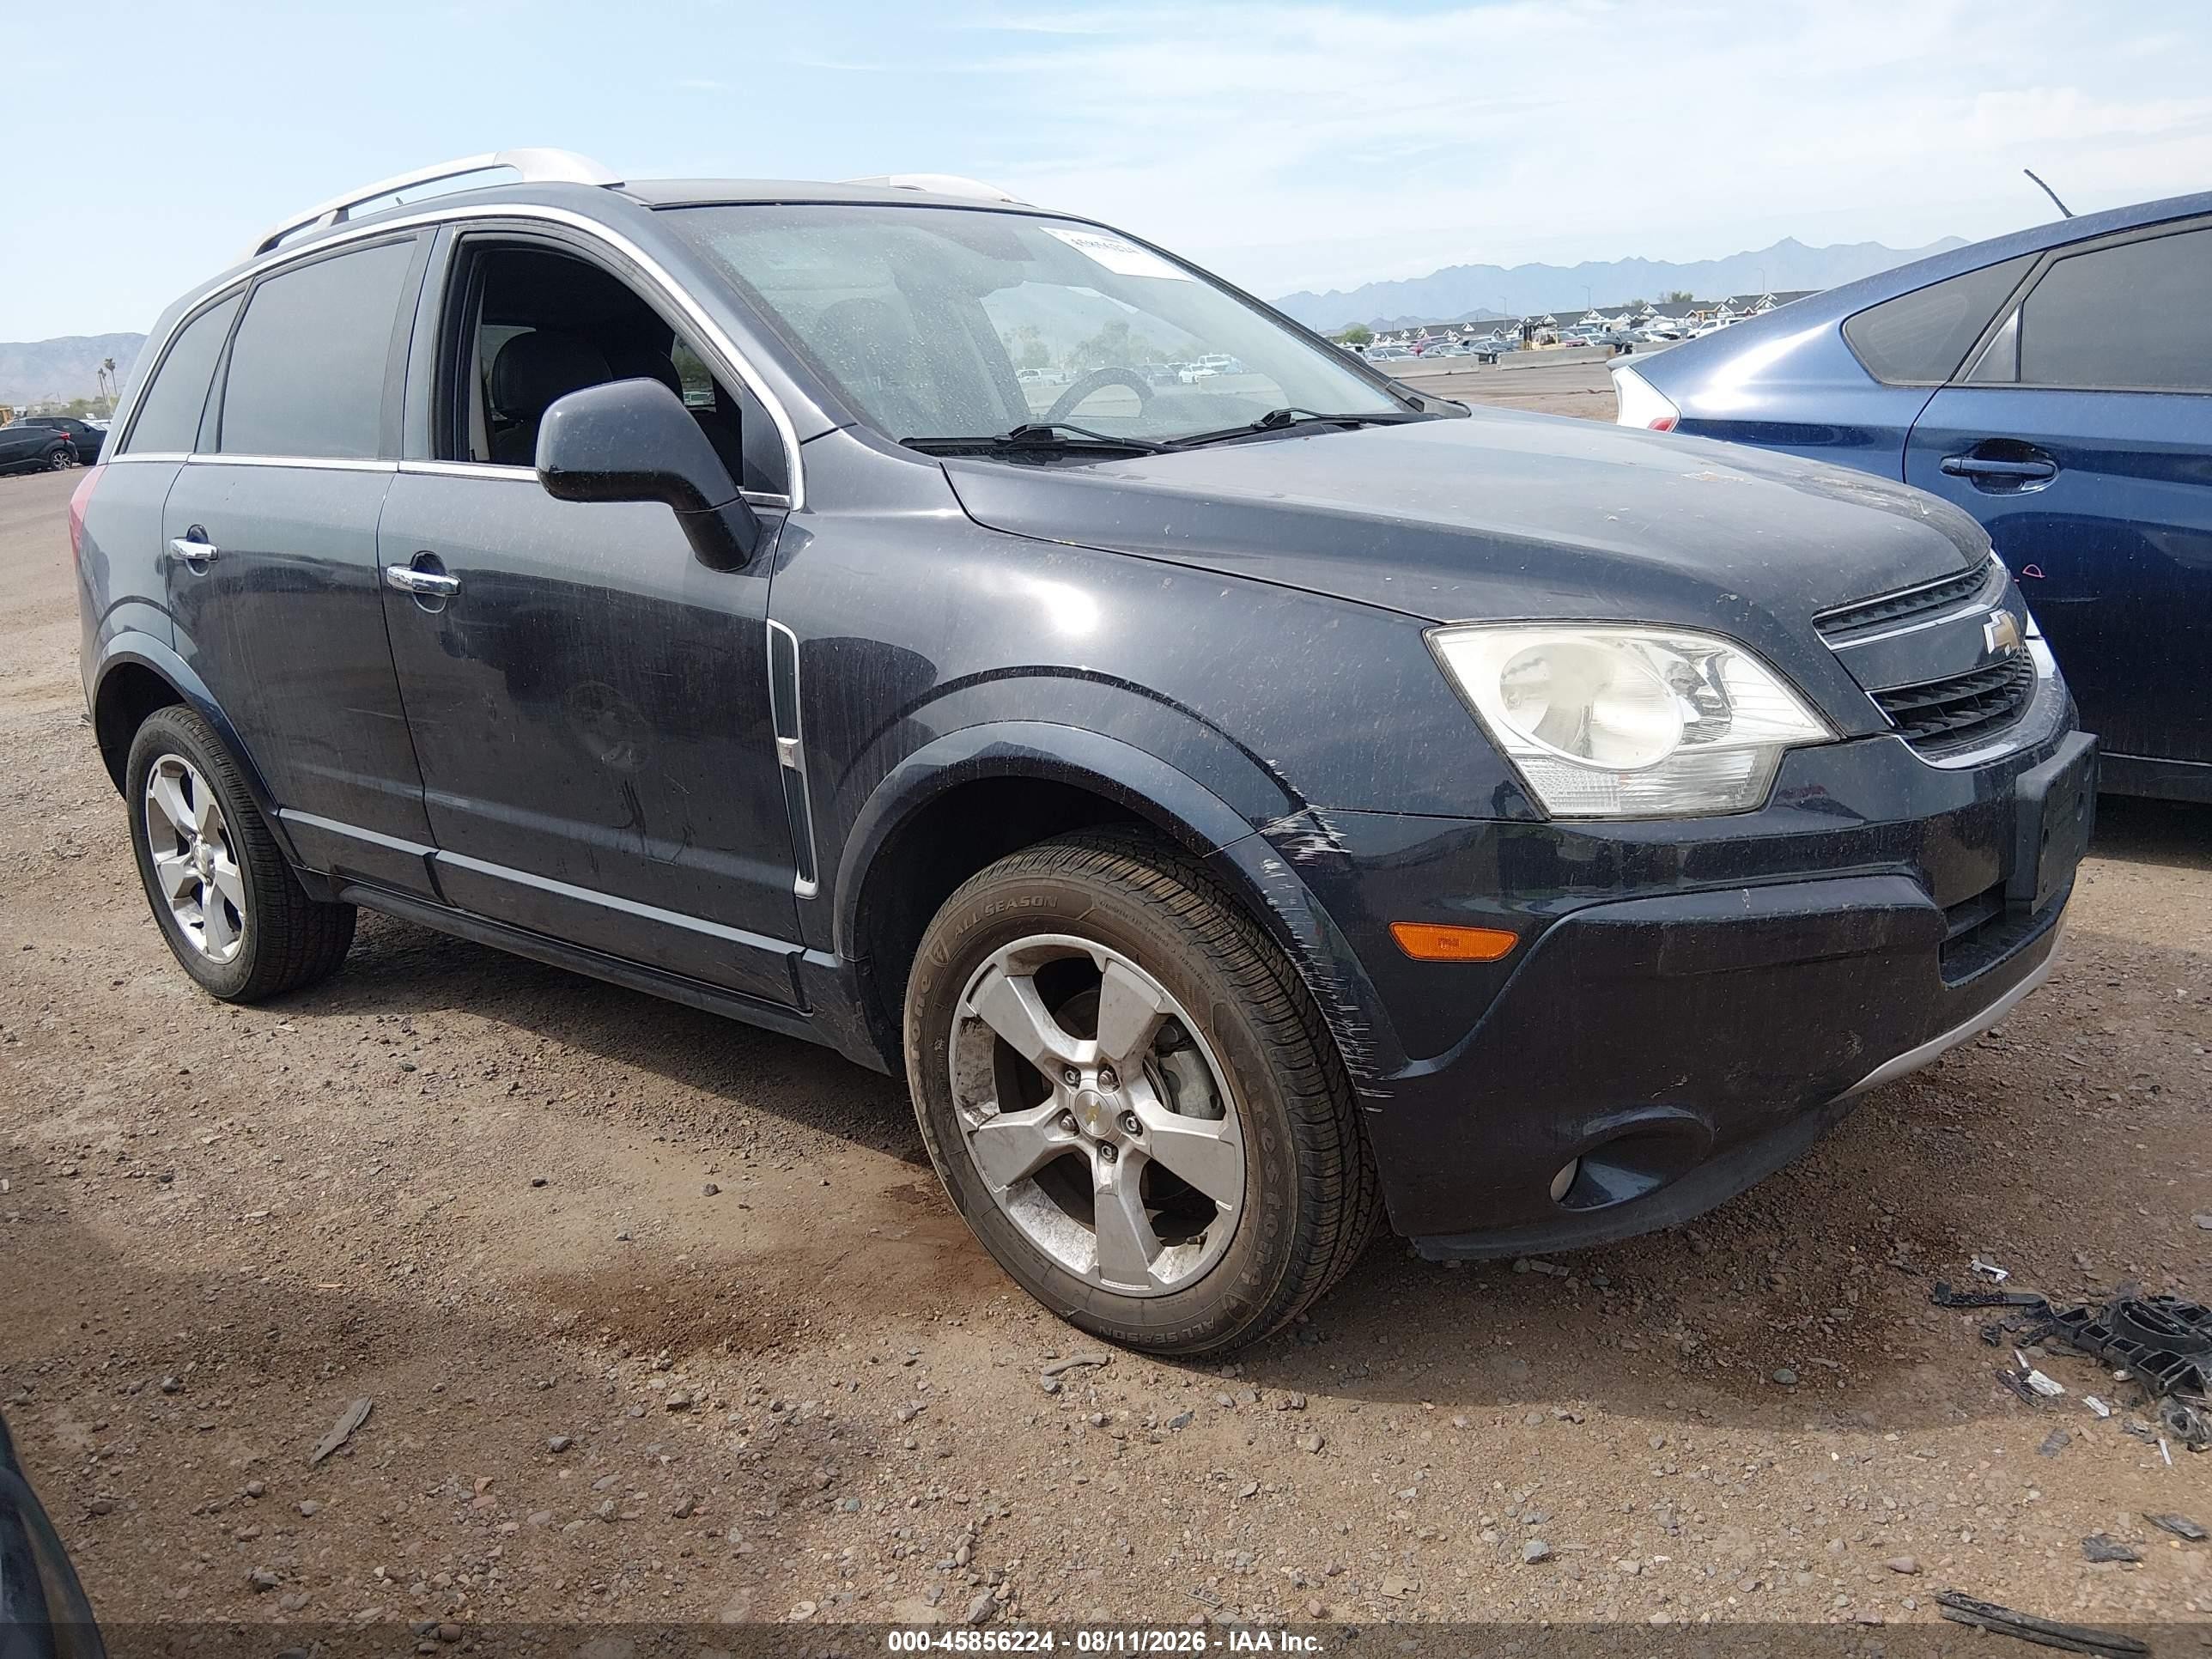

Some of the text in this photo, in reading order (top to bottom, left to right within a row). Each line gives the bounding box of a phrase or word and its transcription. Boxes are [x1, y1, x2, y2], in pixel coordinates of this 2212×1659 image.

[954, 895, 1059, 940] ALL SEASON
[1097, 1315, 1216, 1345] ALL SEASON
